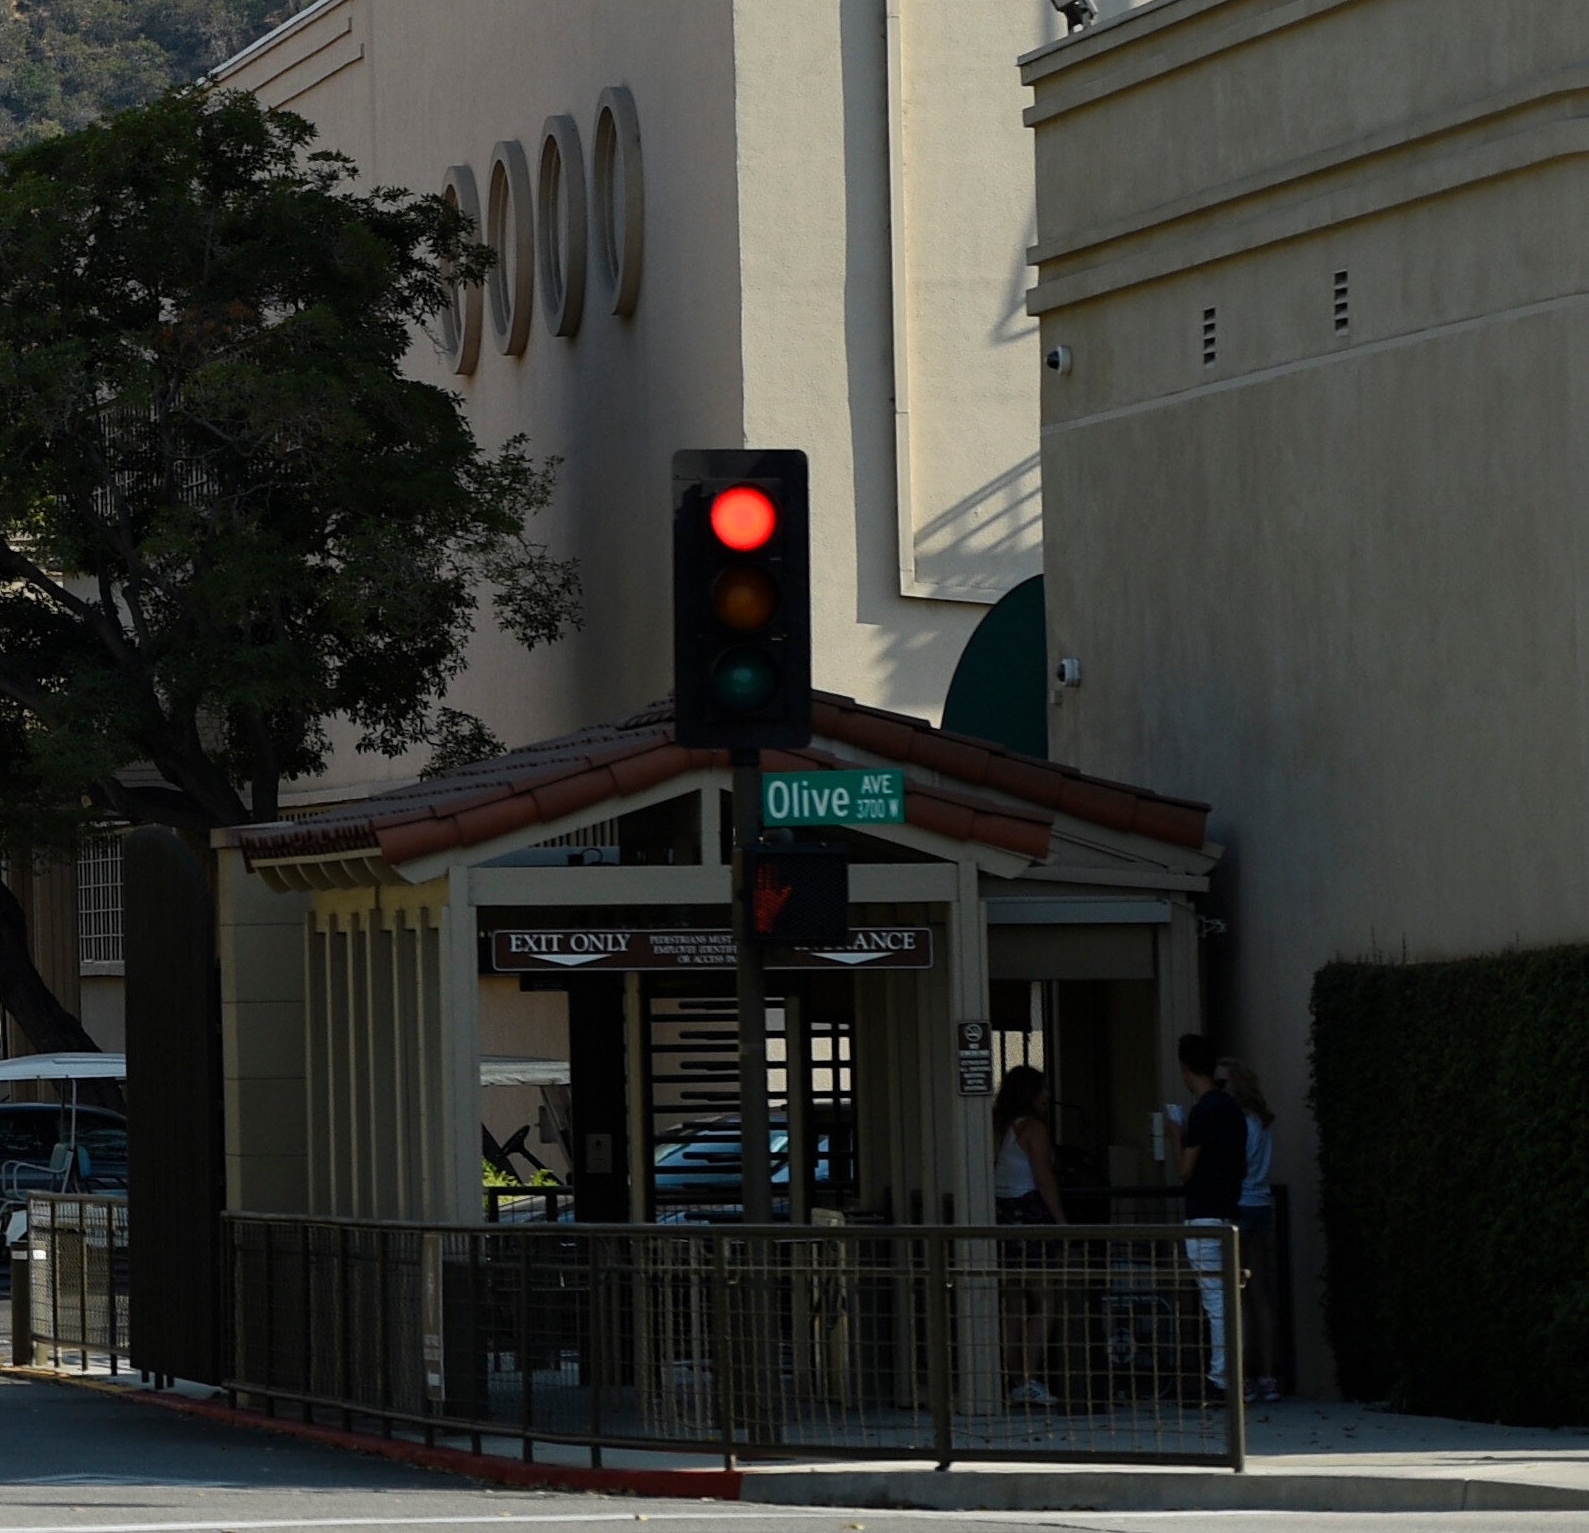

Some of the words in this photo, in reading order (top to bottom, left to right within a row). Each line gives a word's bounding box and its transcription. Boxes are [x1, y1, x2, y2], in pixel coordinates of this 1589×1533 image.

[767, 780, 851, 820] Olive
[861, 774, 894, 795] AVE
[856, 798, 886, 819] 3700
[888, 798, 900, 818] W
[509, 933, 565, 953] EXIT
[569, 933, 631, 953] ONLY
